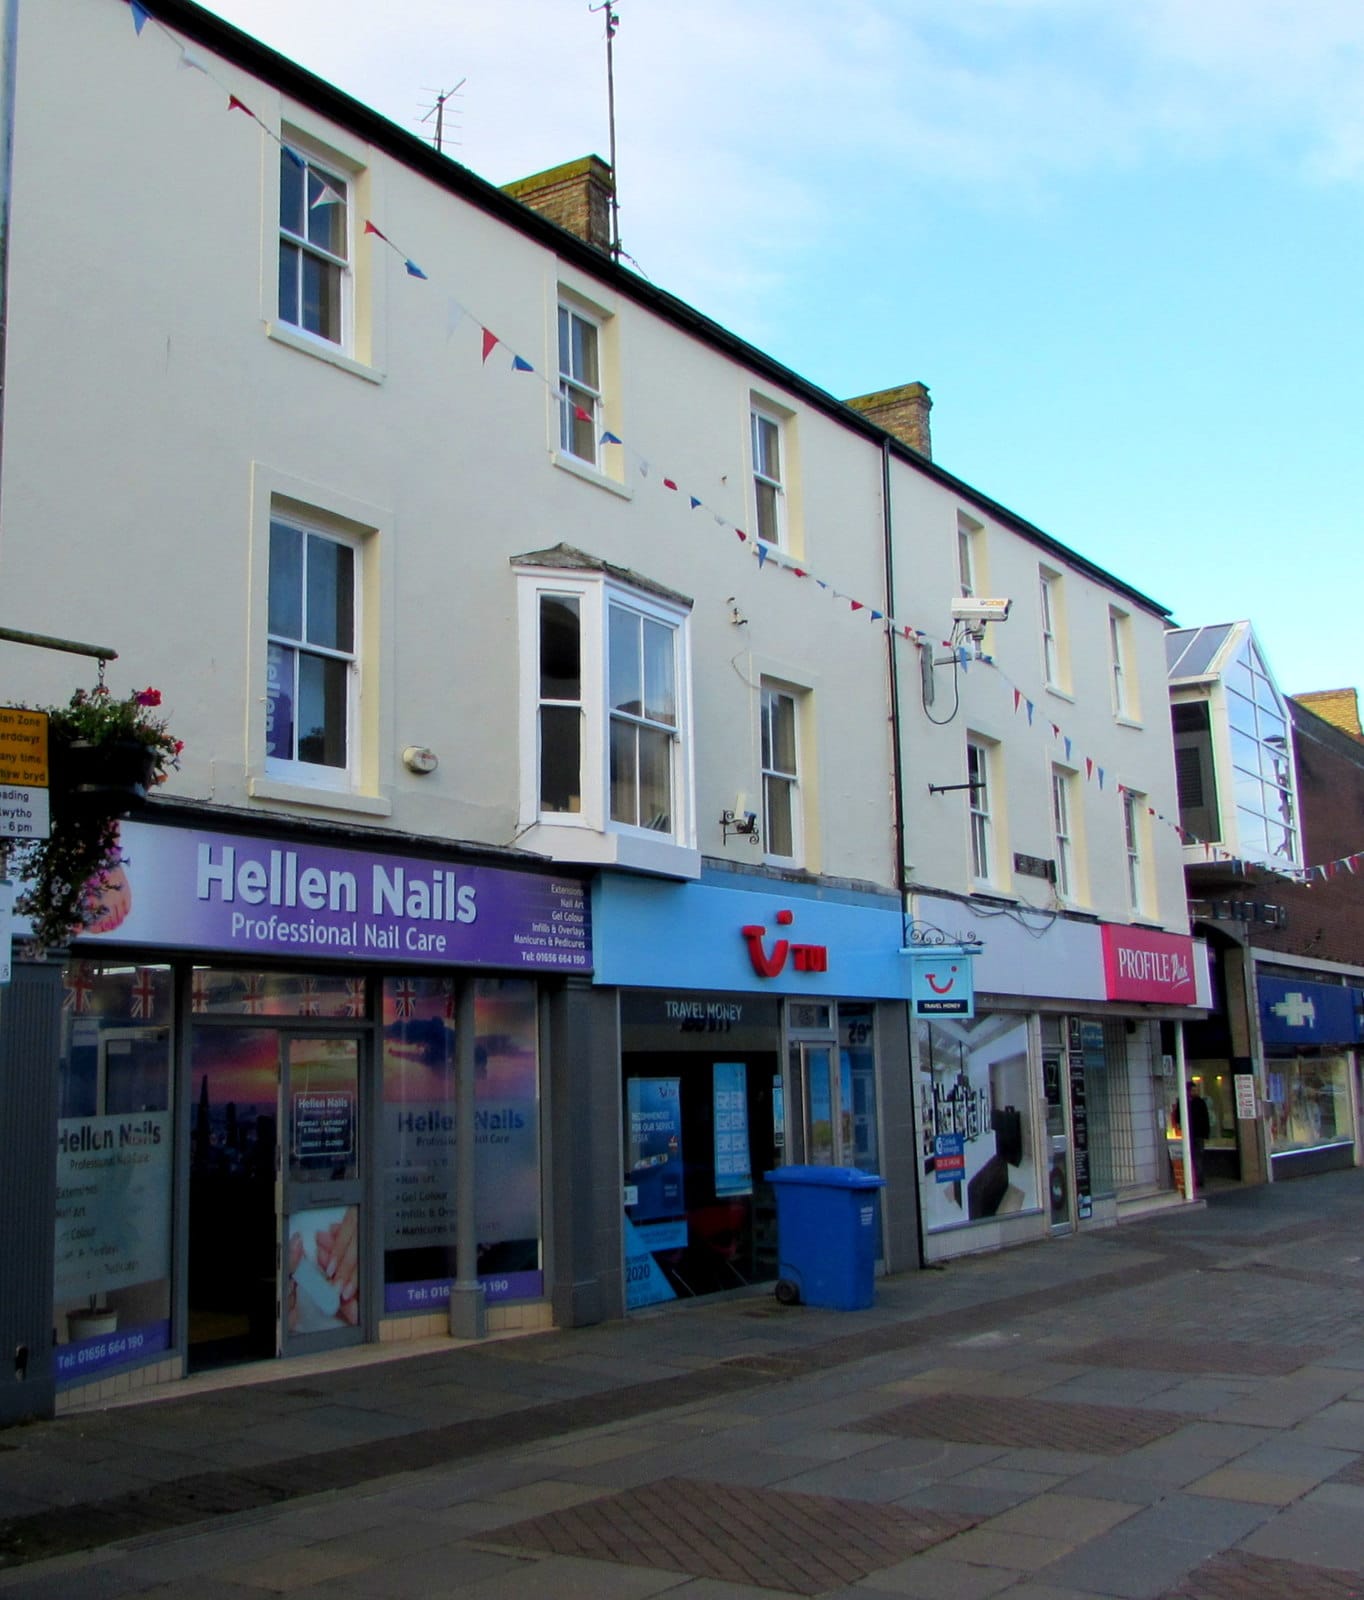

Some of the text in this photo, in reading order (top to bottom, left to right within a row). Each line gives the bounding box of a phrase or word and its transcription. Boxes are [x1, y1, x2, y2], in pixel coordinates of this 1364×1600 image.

[17, 714, 41, 728] Zone
[20, 752, 41, 764] time
[9, 821, 15, 832] 6
[17, 823, 32, 834] pm
[197, 842, 477, 923] Hellen Nails
[551, 883, 585, 897] Extensions
[560, 898, 573, 909] Nail
[551, 910, 585, 923] Gel Colour
[231, 911, 447, 953] Professional Nail Care
[532, 922, 550, 934] Infills
[558, 924, 585, 938] Overlays
[513, 933, 547, 947] Manicures
[554, 936, 586, 949] Pedicures
[521, 951, 535, 962] Tel:
[1118, 947, 1188, 983] PROFILE Pink
[664, 1001, 743, 1021] TRAVEL MONEY
[923, 1002, 961, 1010] TRAVEL MONEY
[298, 1096, 348, 1109] Hellen Nails
[398, 1110, 458, 1133] Helle
[120, 1120, 161, 1148] Nails
[407, 1288, 428, 1302] Tel:
[430, 1284, 450, 1299] 016
[489, 1280, 509, 1294] 190
[57, 1353, 76, 1370] Tel:
